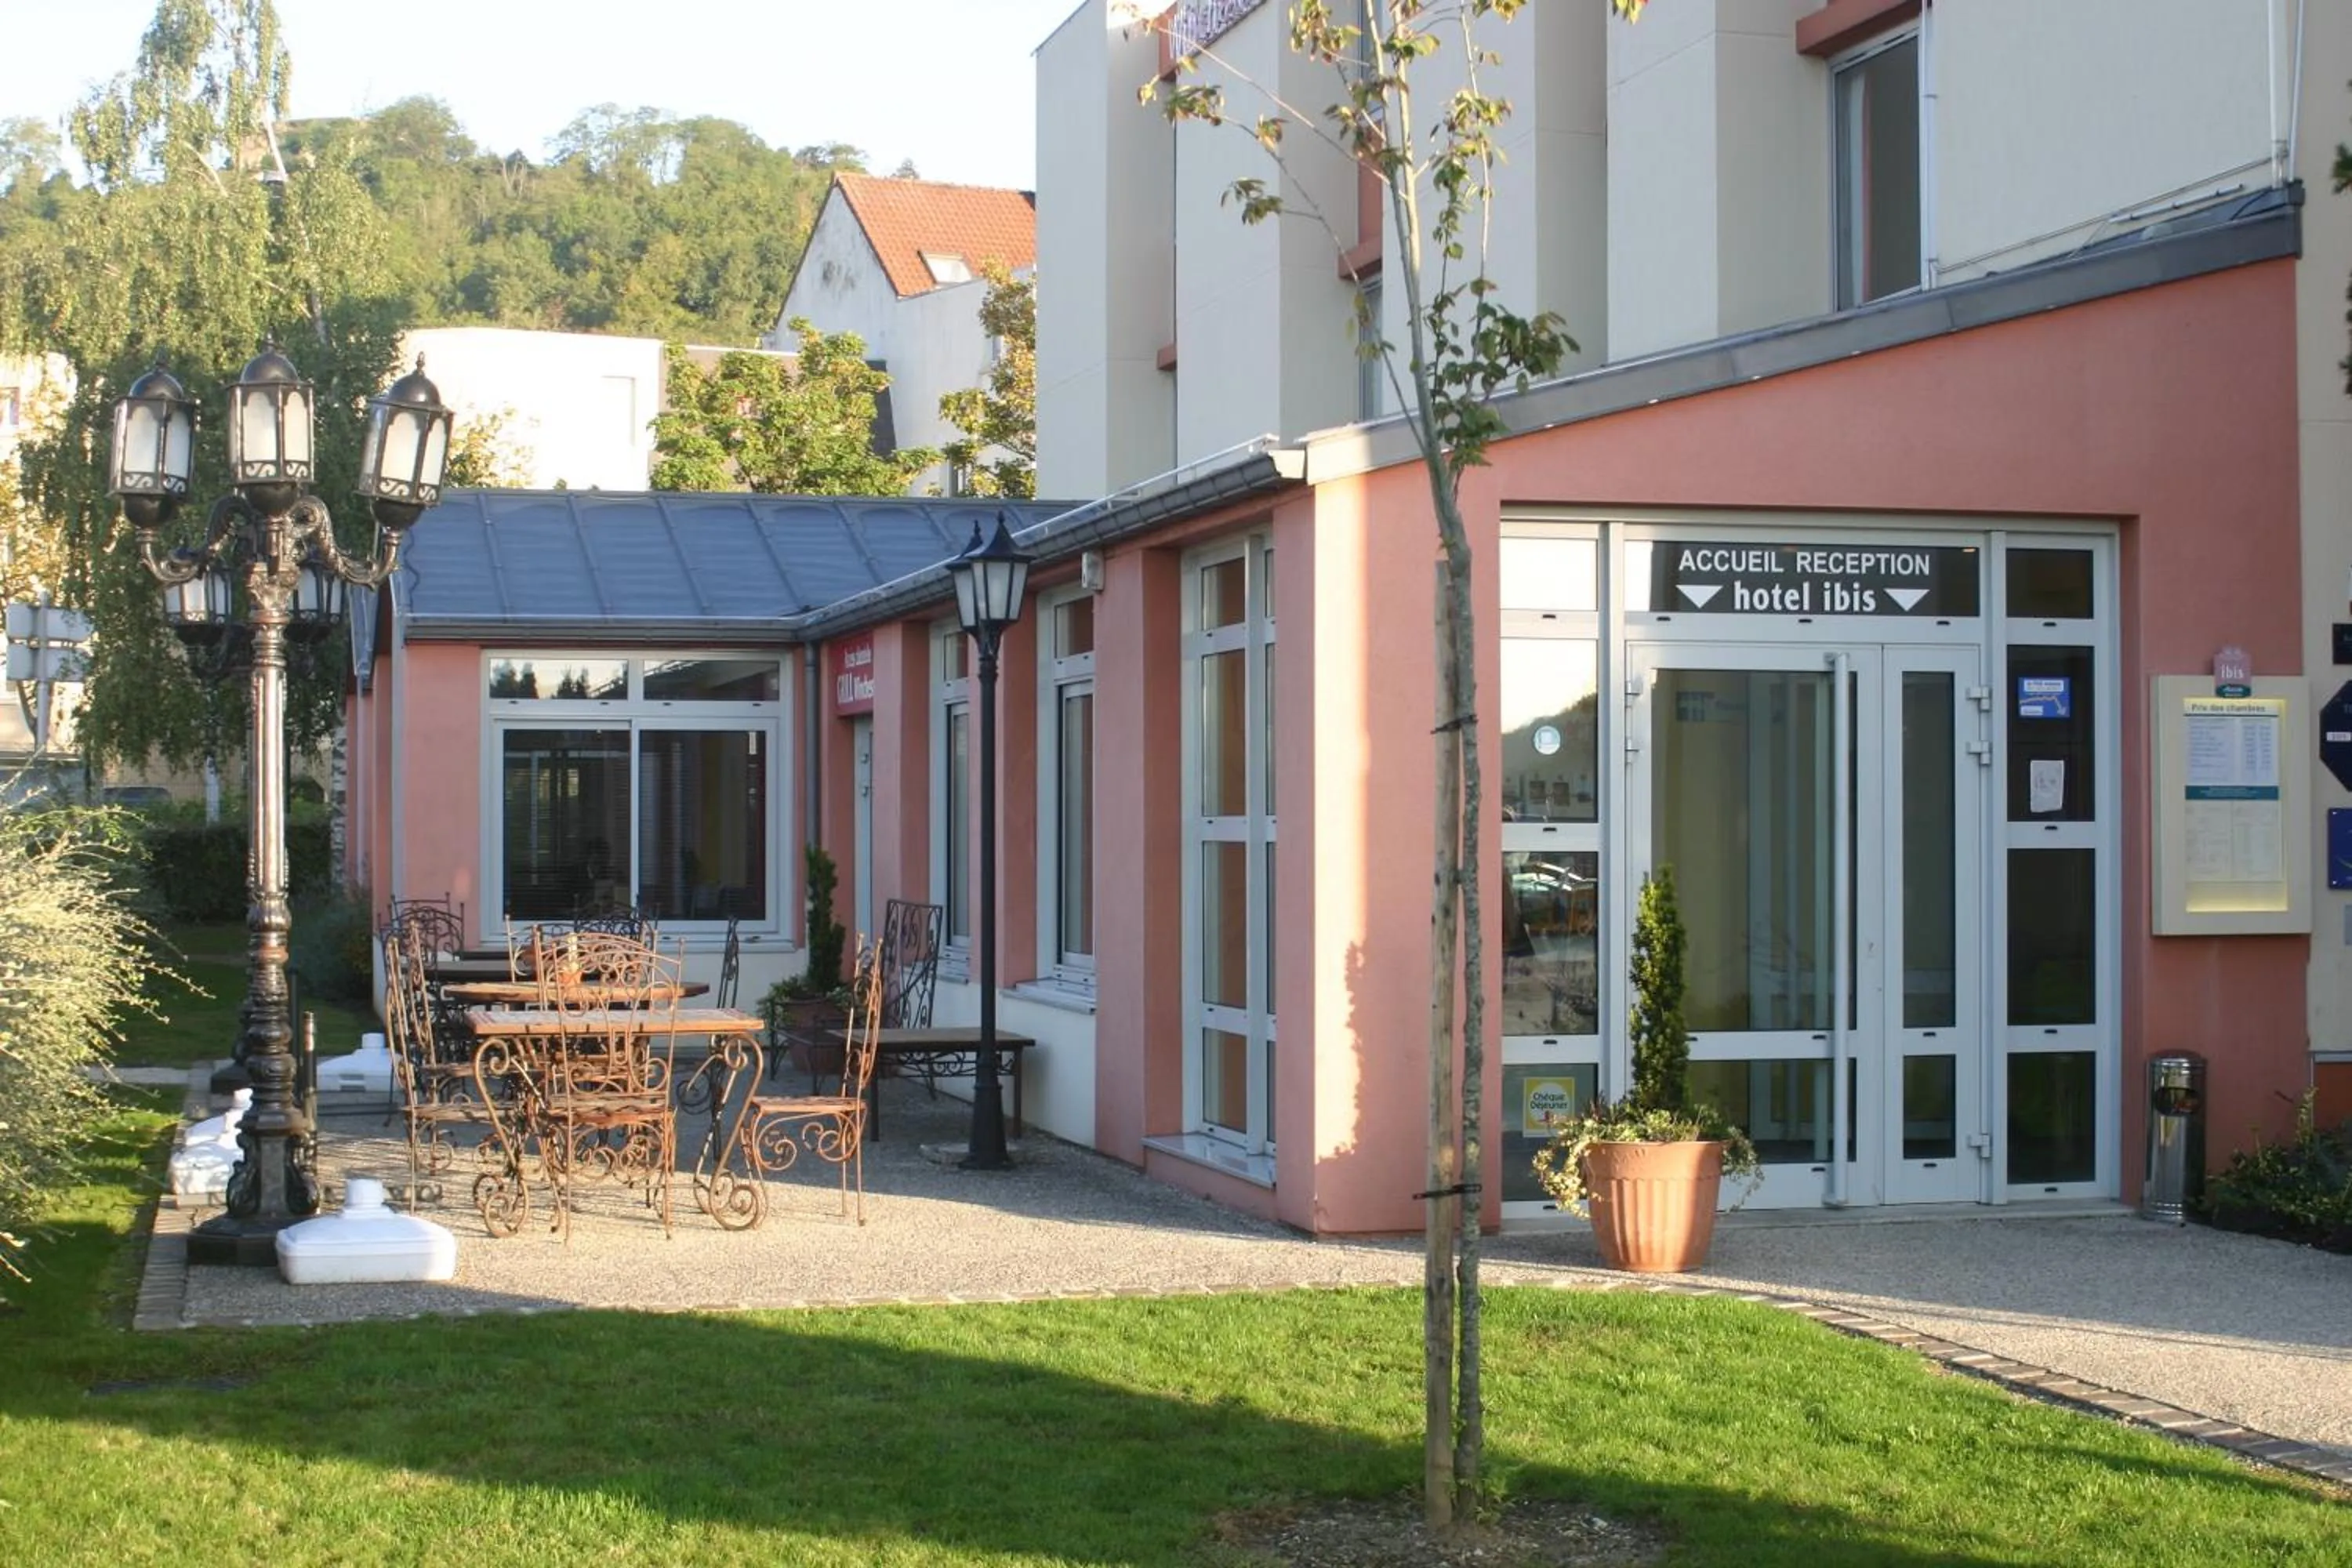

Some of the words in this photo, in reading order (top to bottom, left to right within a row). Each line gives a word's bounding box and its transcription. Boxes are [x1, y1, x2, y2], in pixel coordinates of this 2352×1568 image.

[1679, 550, 1784, 573] ACCUEIL
[1796, 550, 1929, 575] RECEPTION
[1733, 580, 1809, 611] hotel
[1823, 582, 1876, 612] ibis
